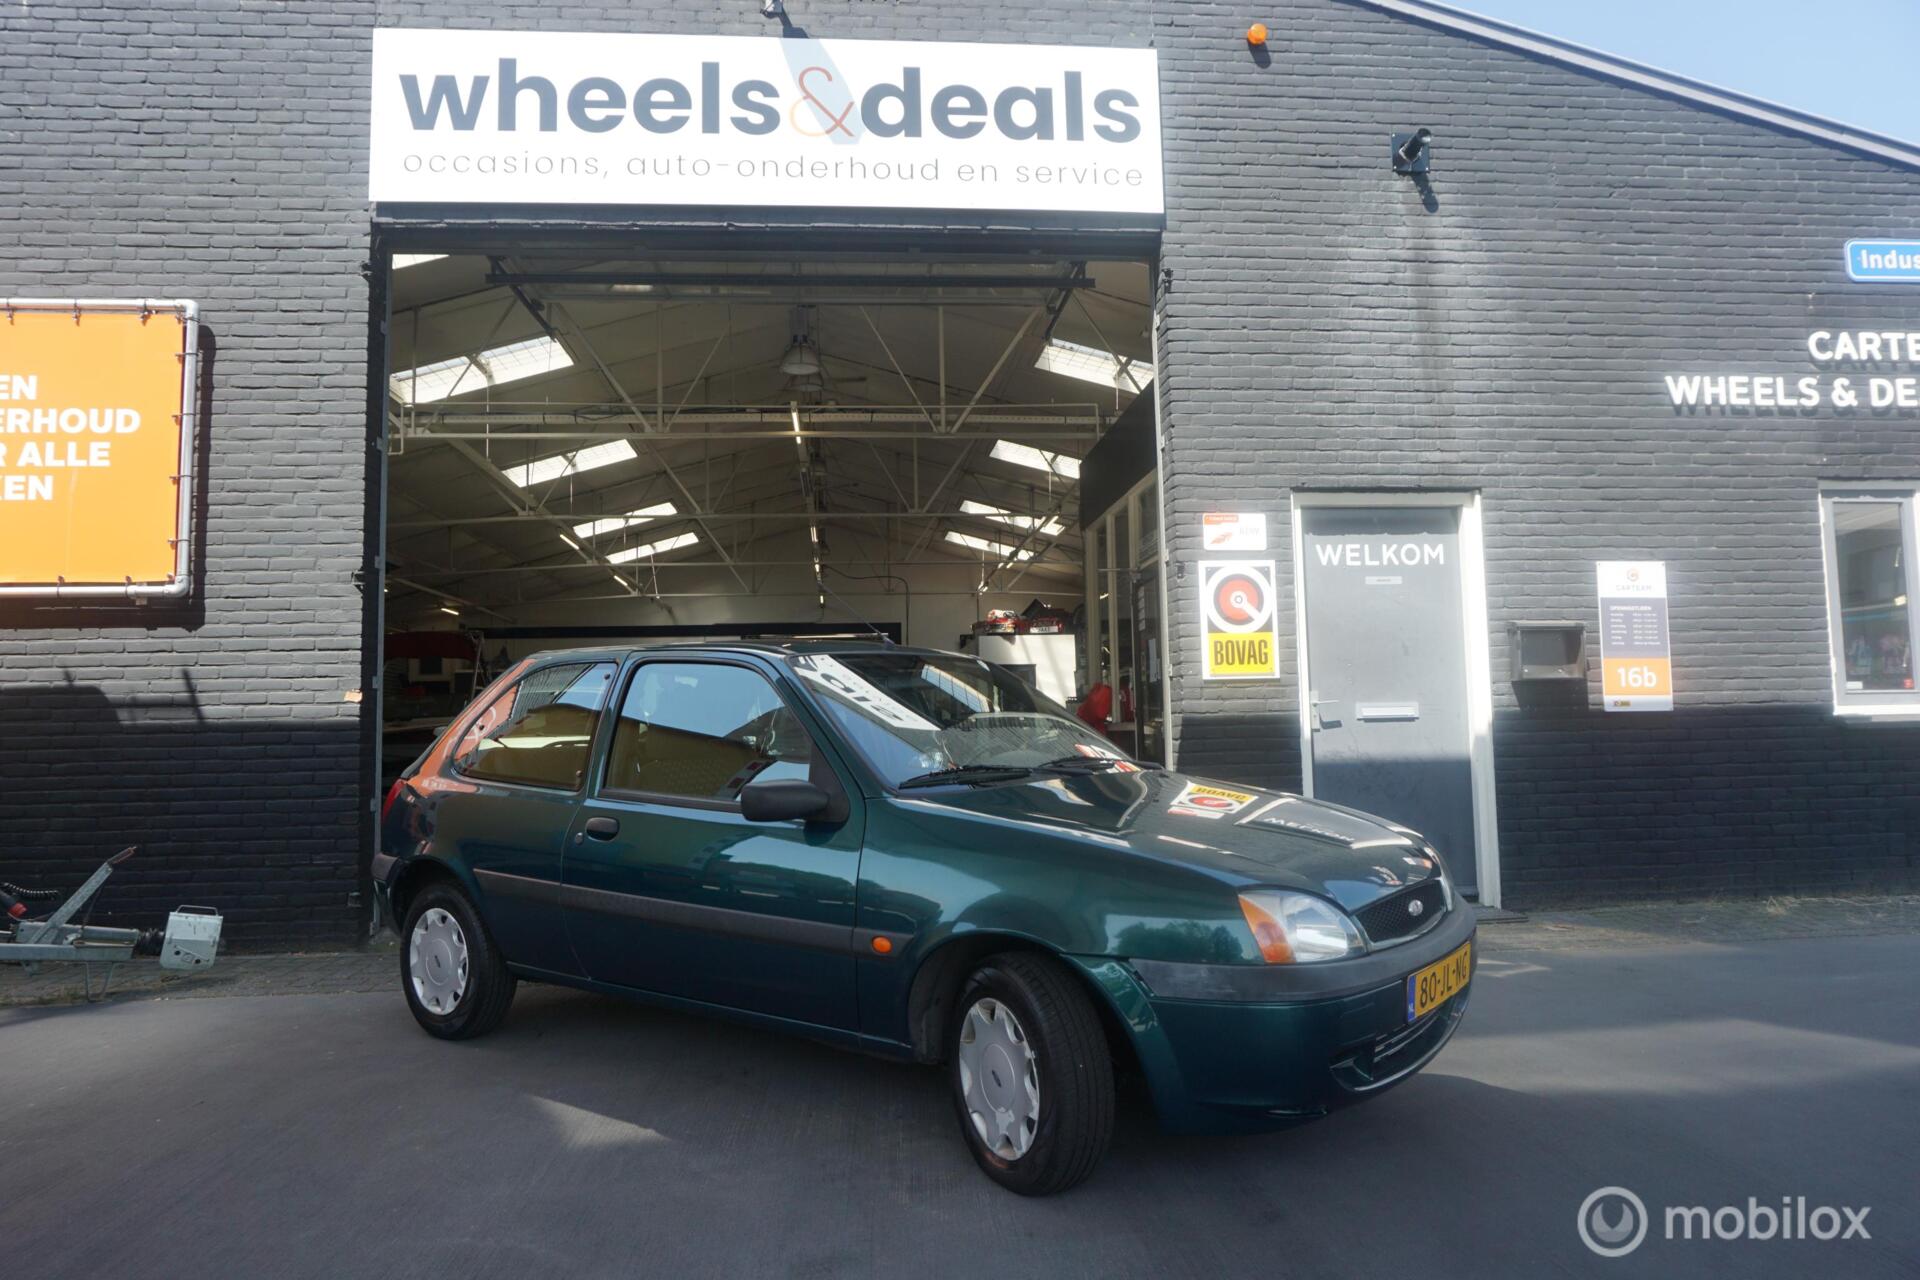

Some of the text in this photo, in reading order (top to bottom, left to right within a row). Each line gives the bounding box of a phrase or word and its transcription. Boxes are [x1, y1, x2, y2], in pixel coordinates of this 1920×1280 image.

[403, 150, 1143, 187] occasions, auto-onderhoud en service
[1808, 330, 1920, 361] CARTE
[1665, 375, 1820, 407] WHEELS
[1831, 377, 1858, 407] &
[0, 407, 141, 435] RHOUD
[16, 441, 111, 468] ALLE
[0, 474, 54, 501] EN
[1315, 543, 1445, 566] WELKOM
[1213, 639, 1269, 666] BOVAG
[1617, 666, 1657, 688] 16b
[1419, 951, 1468, 1009] 80-JL-NG
